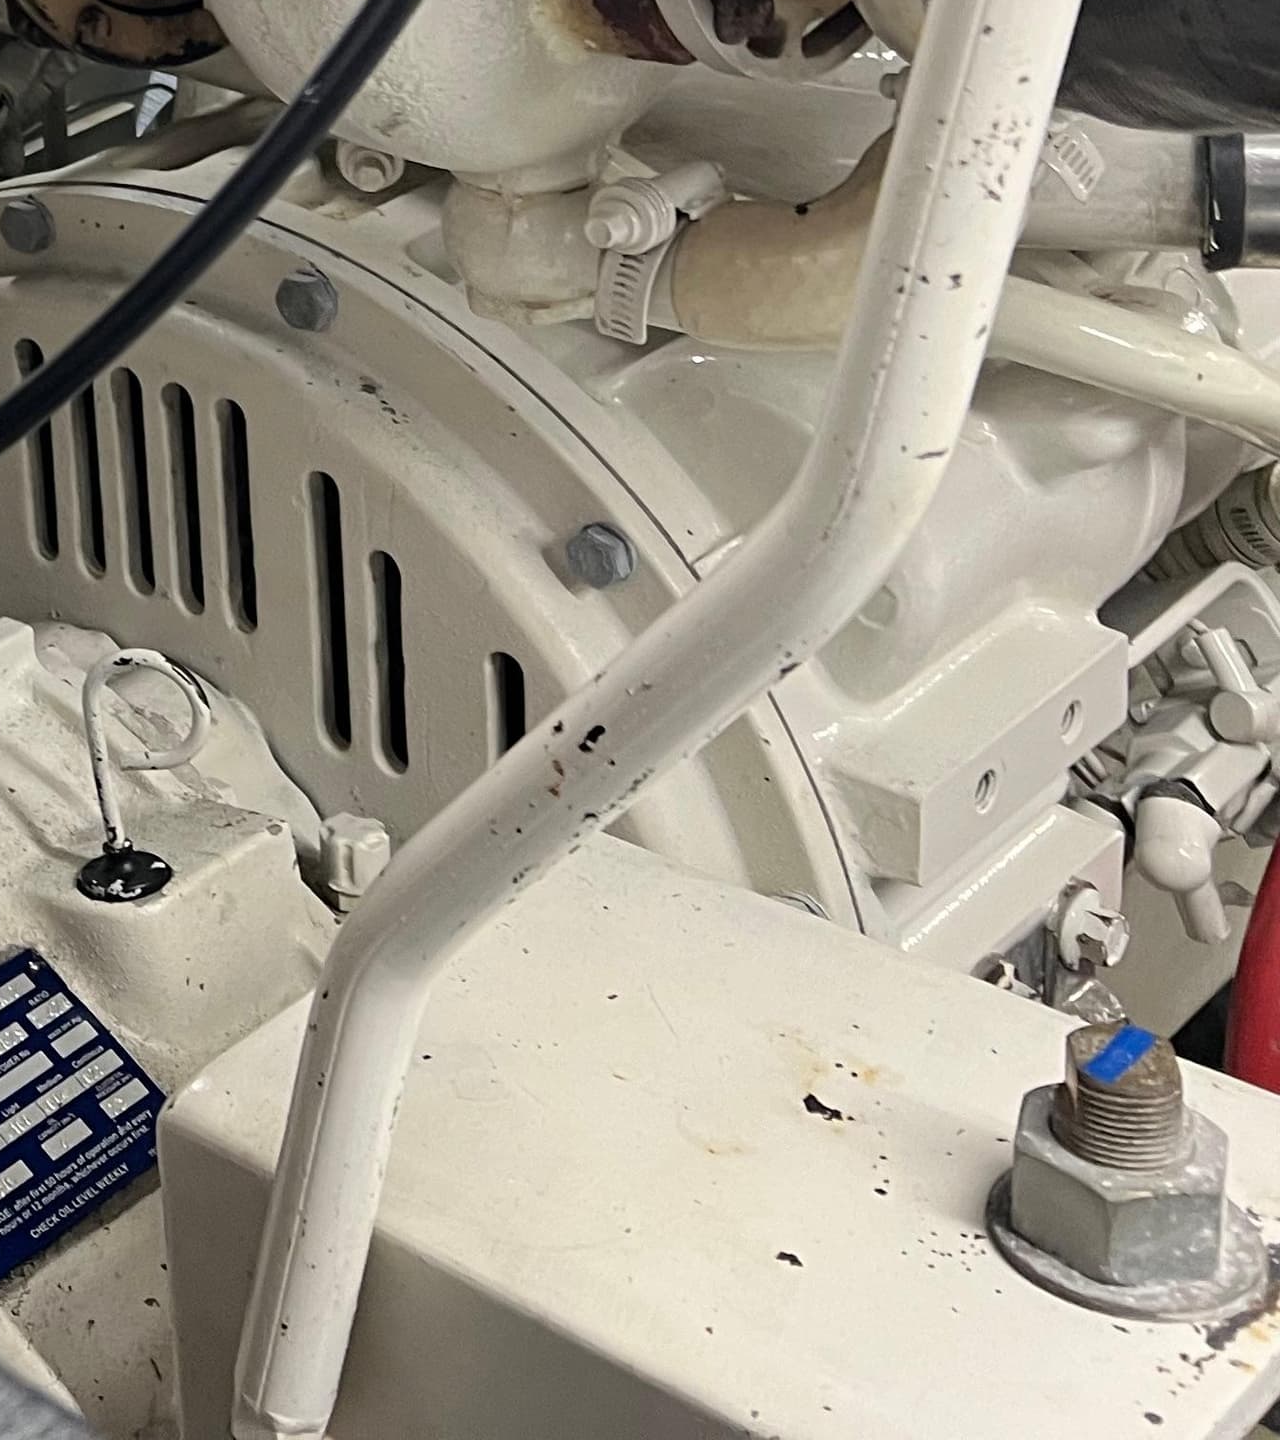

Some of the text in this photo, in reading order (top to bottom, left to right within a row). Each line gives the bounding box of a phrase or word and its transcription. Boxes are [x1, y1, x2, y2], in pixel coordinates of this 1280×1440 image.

[27, 988, 49, 1007] RATIO
[0, 1100, 21, 1119] Light
[11, 1192, 32, 1212] after
[29, 1182, 47, 1199] first
[43, 1174, 56, 1187] 50
[53, 1159, 78, 1181] hours
[74, 1152, 86, 1166] of
[83, 1130, 120, 1161] operation
[115, 1119, 132, 1136] and
[130, 1108, 153, 1127] every
[21, 1207, 32, 1220] or
[30, 1198, 43, 1212] 12
[70, 1151, 109, 1184] whichever
[106, 1134, 134, 1158] occurs
[28, 1161, 130, 1240] CHECK OIL LEVEL WEEKLY
